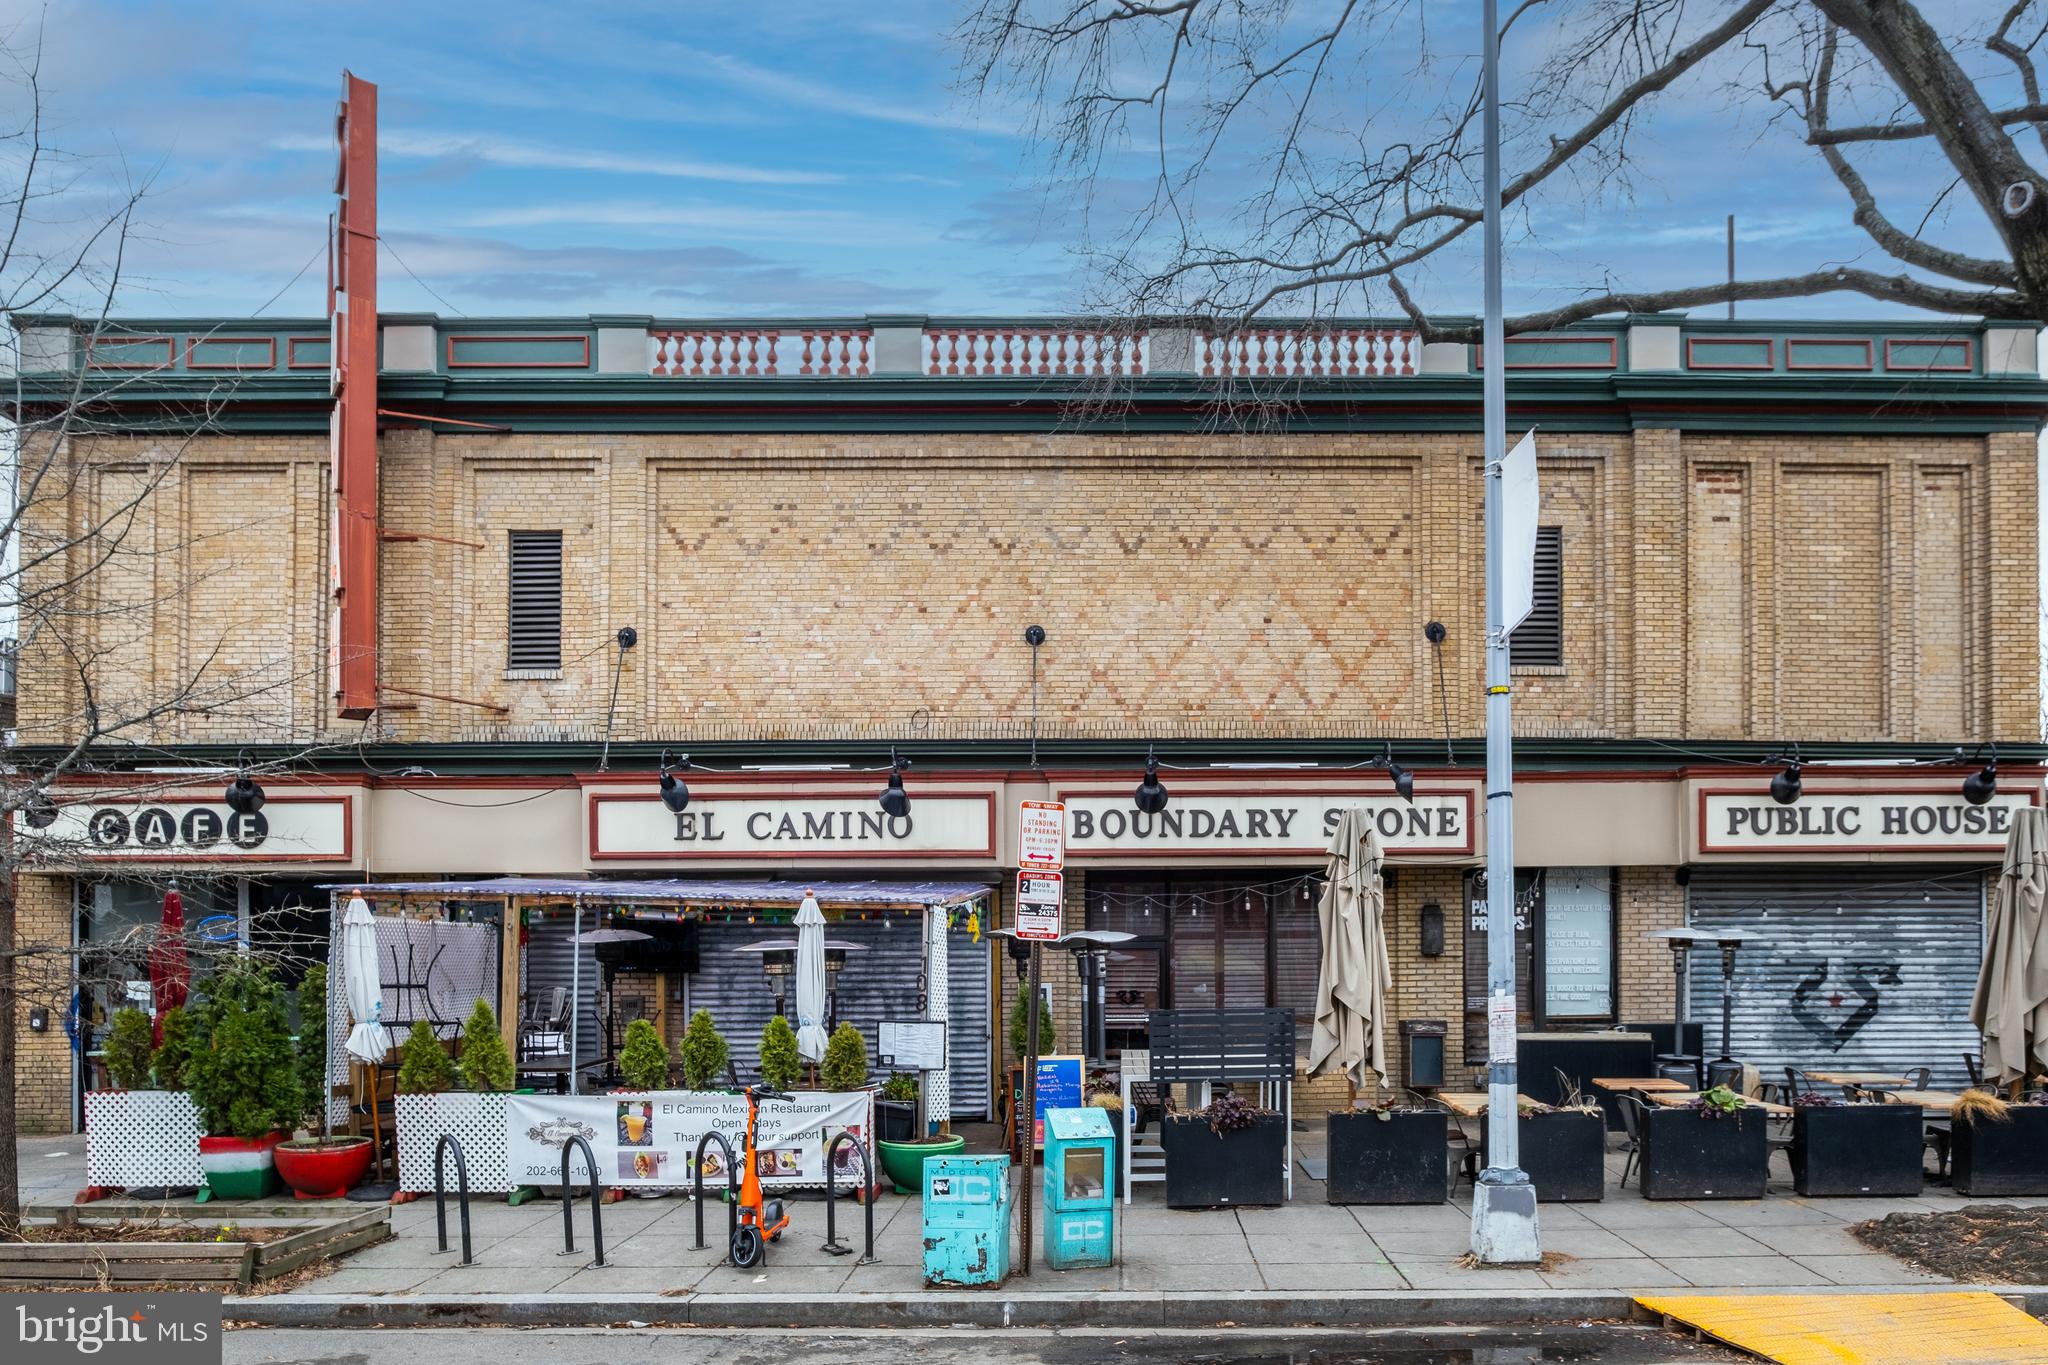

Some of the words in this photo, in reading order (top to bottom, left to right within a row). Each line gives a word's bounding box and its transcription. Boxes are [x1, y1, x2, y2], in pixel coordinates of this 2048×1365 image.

[673, 812, 725, 841] EL
[746, 811, 913, 840] CAMINO
[1027, 819, 1057, 827] STANDING
[1071, 808, 1298, 839] BOUNDARY
[1323, 807, 1461, 837] SONE
[1726, 806, 1861, 835] PUBLIC
[1881, 805, 2011, 835] HOUSE
[1034, 827, 1061, 836] PARKING
[1021, 880, 1029, 892] 2
[662, 1104, 674, 1114] El
[676, 1104, 719, 1115] Camino
[771, 1103, 831, 1114] Restaurant
[711, 1118, 742, 1130] Open
[756, 1118, 782, 1130] days
[673, 1132, 704, 1142] Than
[778, 1131, 820, 1144] support
[526, 1165, 602, 1177] 202-66-100
[930, 1176, 992, 1202] DC
